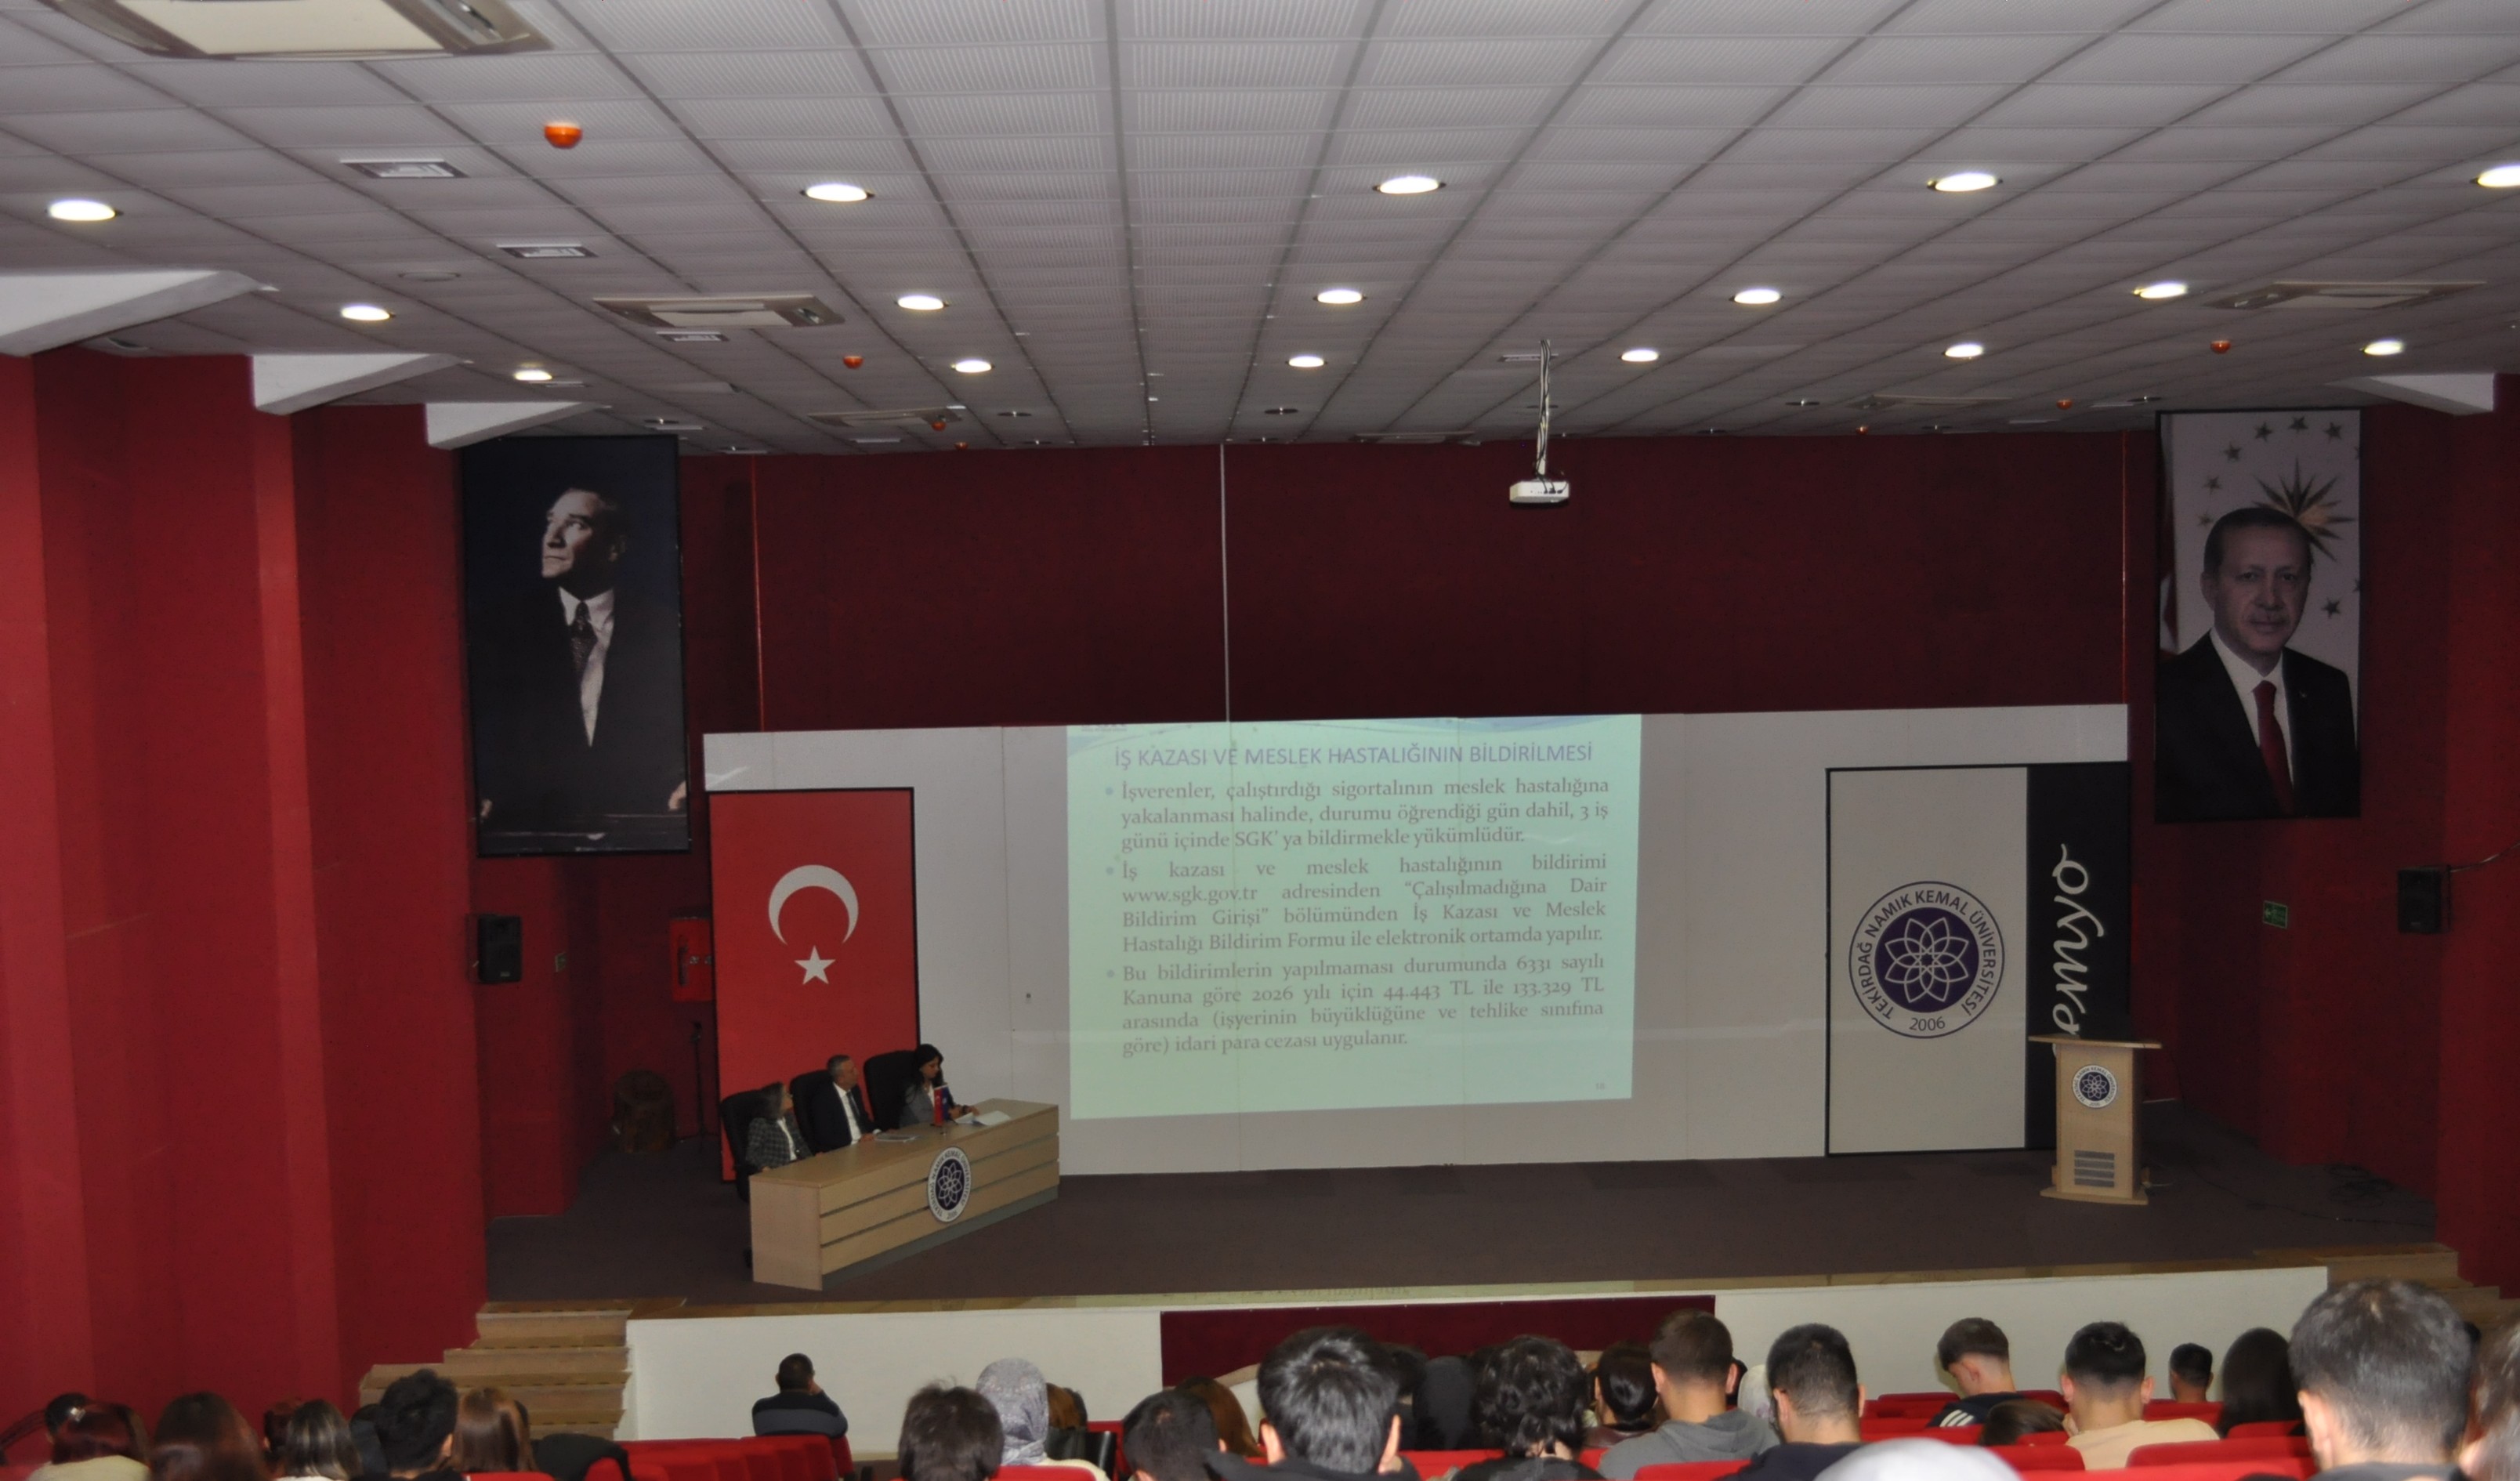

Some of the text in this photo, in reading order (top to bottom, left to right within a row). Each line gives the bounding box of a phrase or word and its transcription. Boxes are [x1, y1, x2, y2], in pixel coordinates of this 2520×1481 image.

[1115, 741, 1591, 770] İŞ KAZASI VE MESLEK HASTALIĞININ BİLDİRİLMESİ
[1122, 777, 1609, 802] İşverenler, çalıştırdığı sigortalının meslek hastalığına
[1121, 802, 1608, 828] yakalanması halinde, durumu öğrendiği gün dahil, 3 iş
[1122, 832, 1168, 854] günü
[1175, 831, 1229, 852] içinde
[1283, 834, 1302, 850] ya
[1308, 828, 1411, 846] bildirmekle
[1414, 827, 1524, 848] yükümlüdür.
[1122, 853, 1606, 881] İş kazası ve meslek hastalığının bildirimi
[1122, 885, 1258, 906] www.sgk.gov.tr
[1282, 882, 1380, 900] adresinden
[1570, 877, 1607, 893] Dair
[1122, 911, 1197, 927] Bildirim
[1284, 906, 1398, 923] bölümünden
[1414, 902, 1428, 922] İş
[1443, 903, 1498, 920] Kazası
[1513, 906, 1531, 917] ve
[1546, 900, 1606, 917] Meslek
[1122, 925, 1602, 954] Hastalığı Bildirim Formu ile elektronik ortamda yapılır.
[1122, 953, 1604, 981] Bu bildirimlerin yapılmaması durumunda 6331 sayılı
[1856, 890, 1997, 1019] TEKİRDAĞ NAMIK KEMAL ÜNİVERSİTESİ
[1122, 976, 1604, 1007] Kanuna göre 2026 yılı için 44.443 TL ile 133.329 TL
[1122, 1001, 1603, 1030] arasında (işyerinin büyüklüğüne ve tehlike sınıfına
[1909, 1016, 1946, 1031] 2006
[1122, 1030, 1407, 1058] göre) idari para cezası uygulanır.
